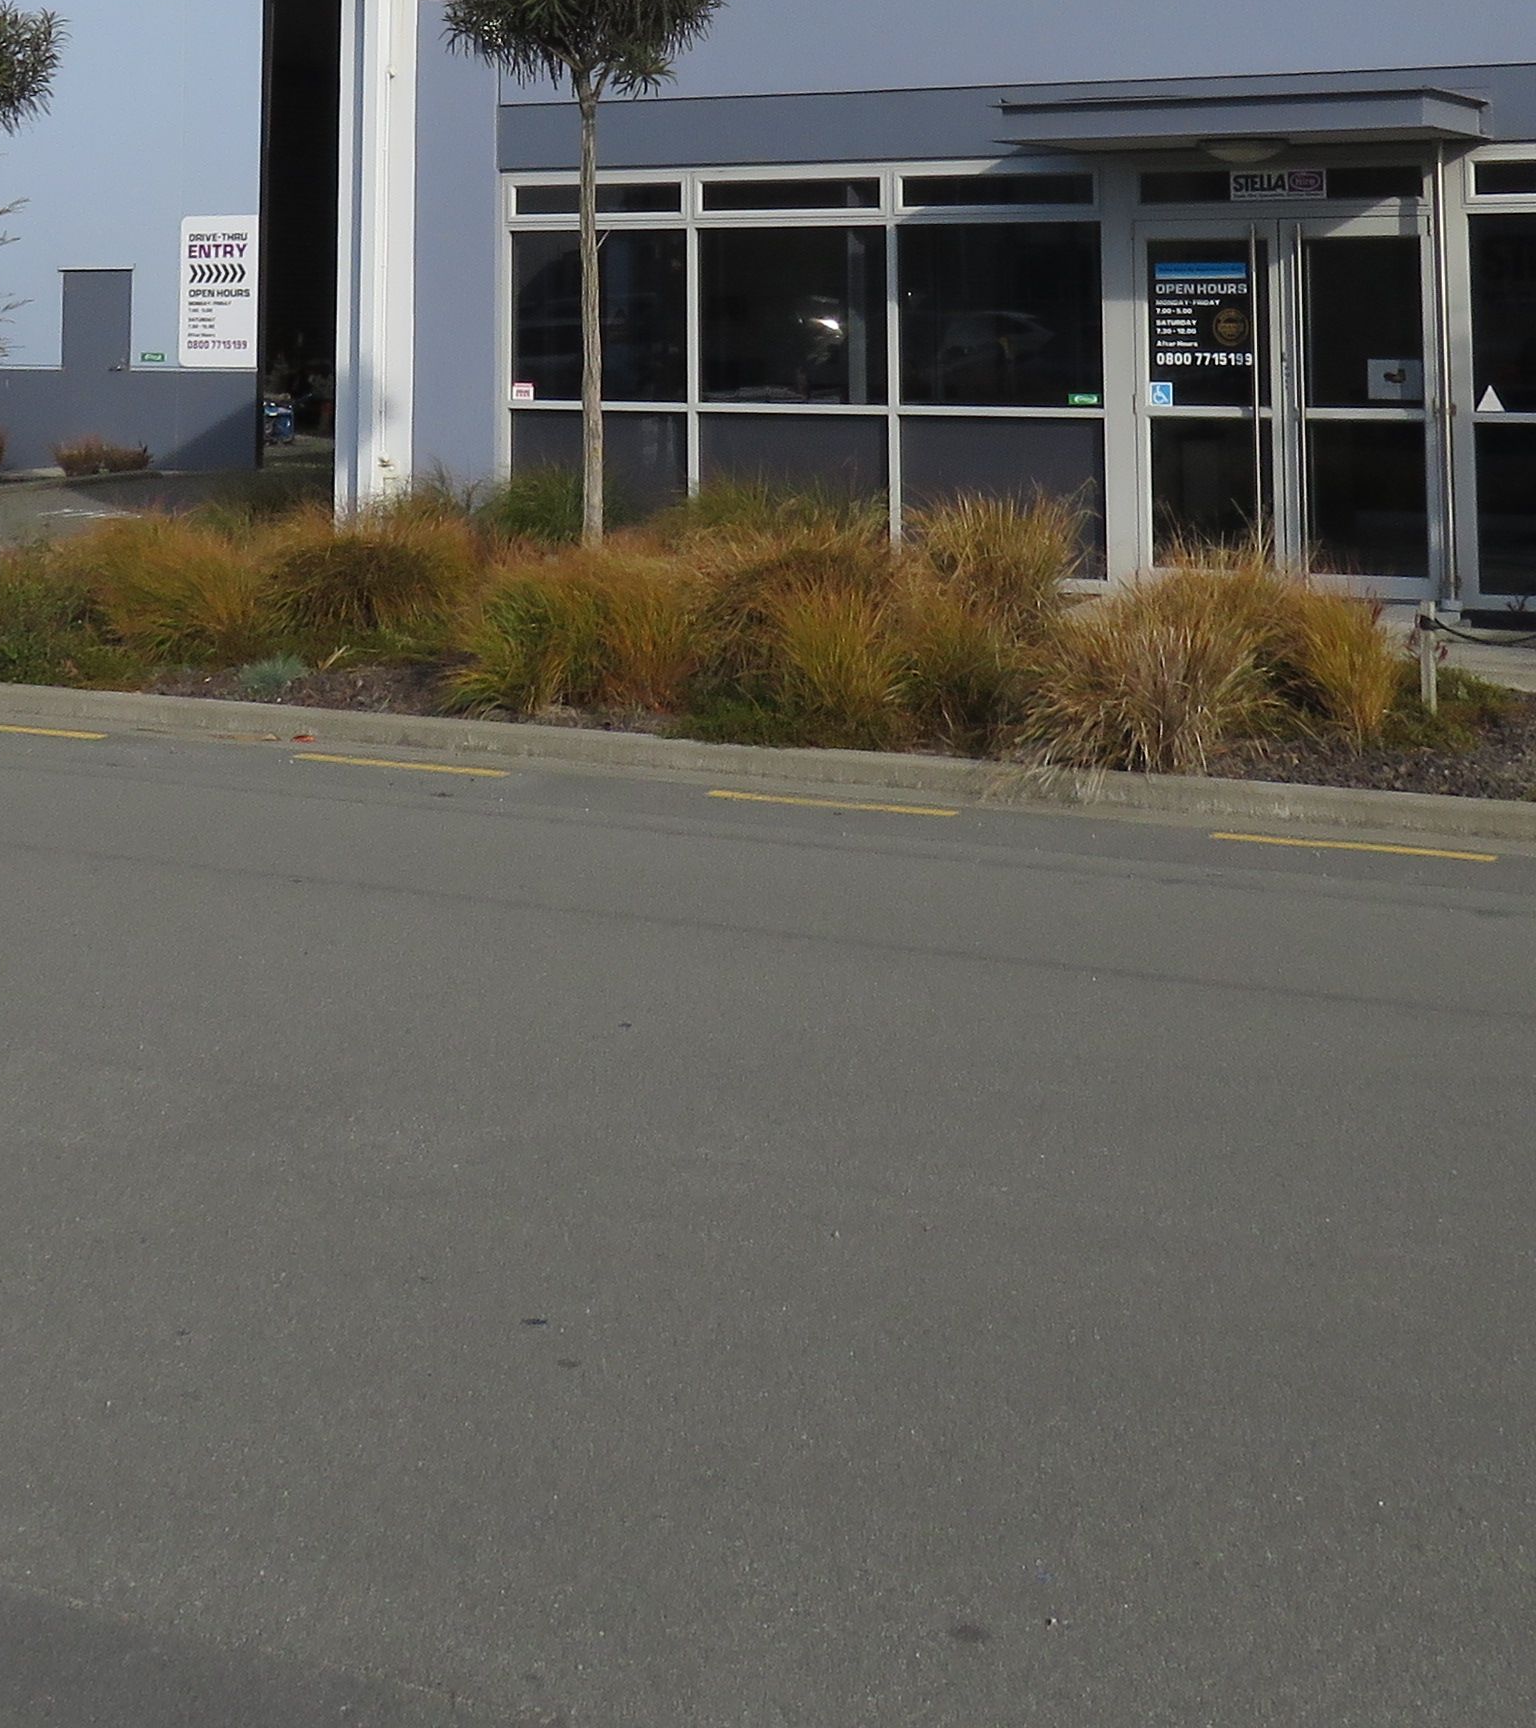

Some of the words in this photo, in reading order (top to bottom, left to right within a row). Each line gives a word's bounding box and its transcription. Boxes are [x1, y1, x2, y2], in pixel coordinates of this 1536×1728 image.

[1232, 174, 1286, 192] STELLA
[188, 232, 248, 242] DRIVE-THRU
[188, 243, 248, 259] ENTRY
[188, 288, 215, 298] OPEN
[216, 288, 251, 298] HOURS
[1155, 283, 1195, 295] OPEN
[1196, 283, 1248, 295] HOURS
[1156, 352, 1192, 366] 0800
